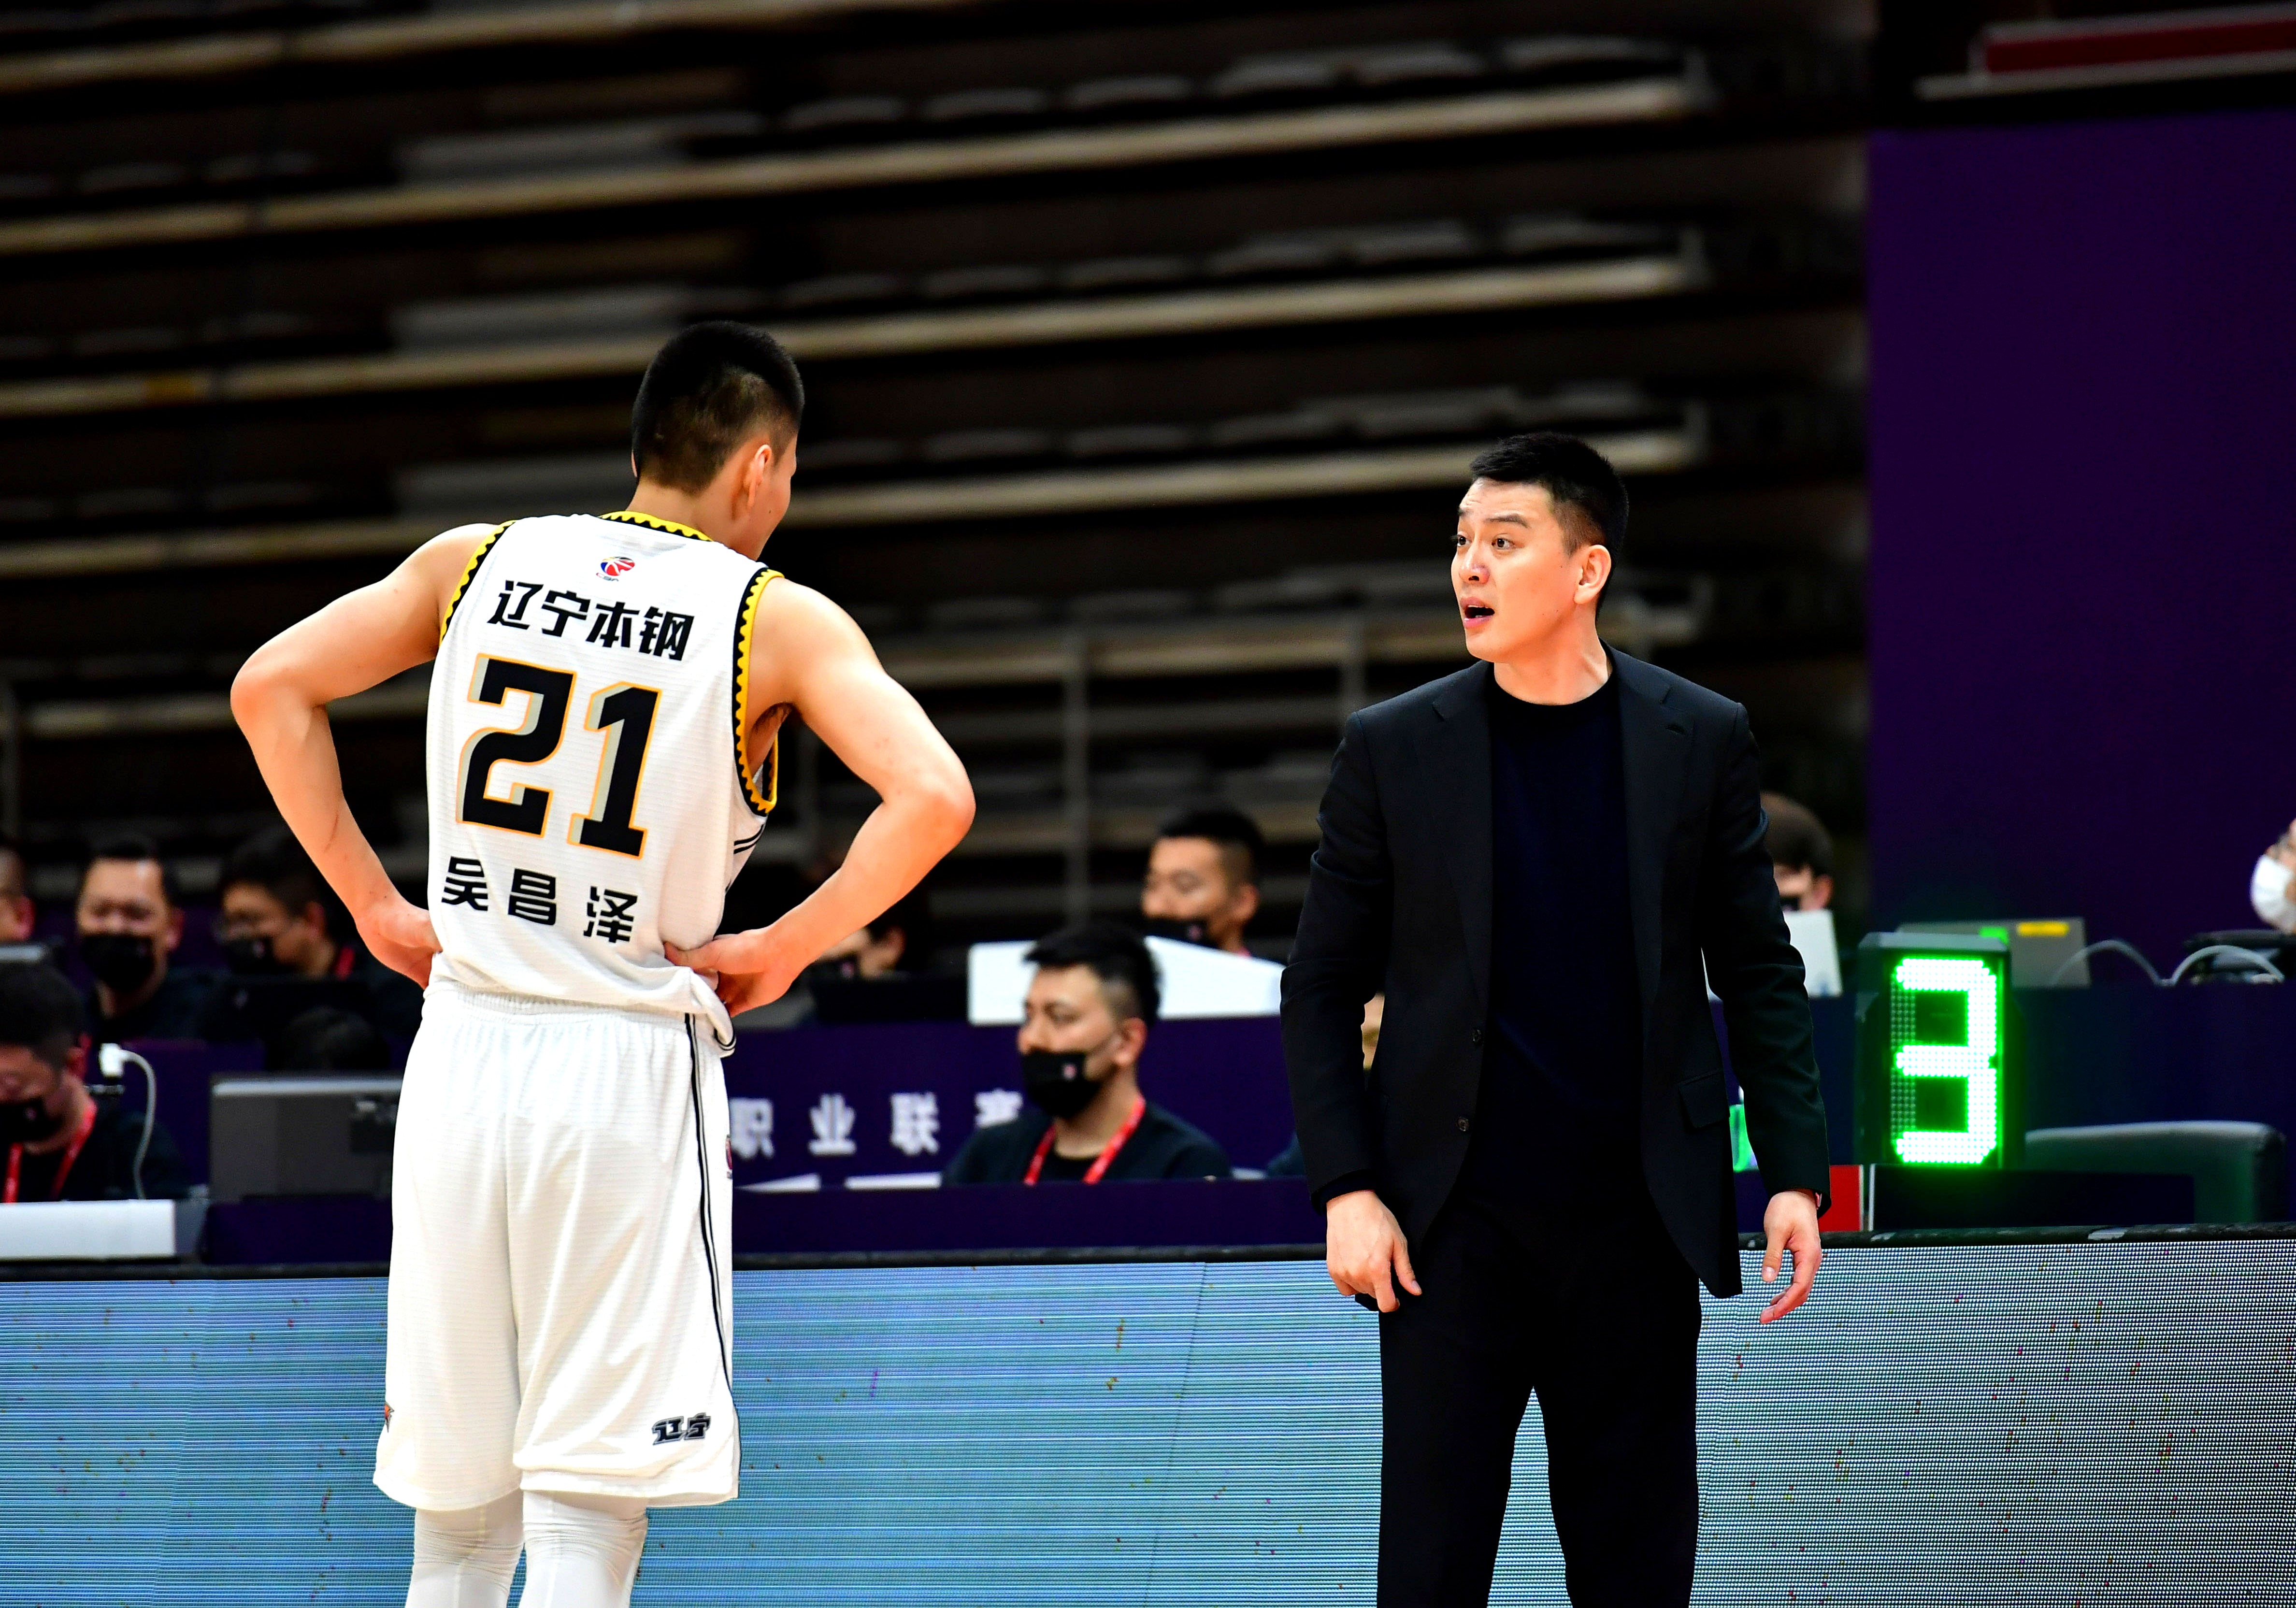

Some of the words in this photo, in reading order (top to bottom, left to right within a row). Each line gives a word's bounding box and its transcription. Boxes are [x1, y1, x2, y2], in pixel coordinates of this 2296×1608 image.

[488, 580, 695, 661] 辽宁本钢
[456, 653, 662, 860] 21
[442, 856, 638, 944] 吴昌泽
[1895, 958, 1997, 1163] 3
[652, 1412, 711, 1445] 辽宁
